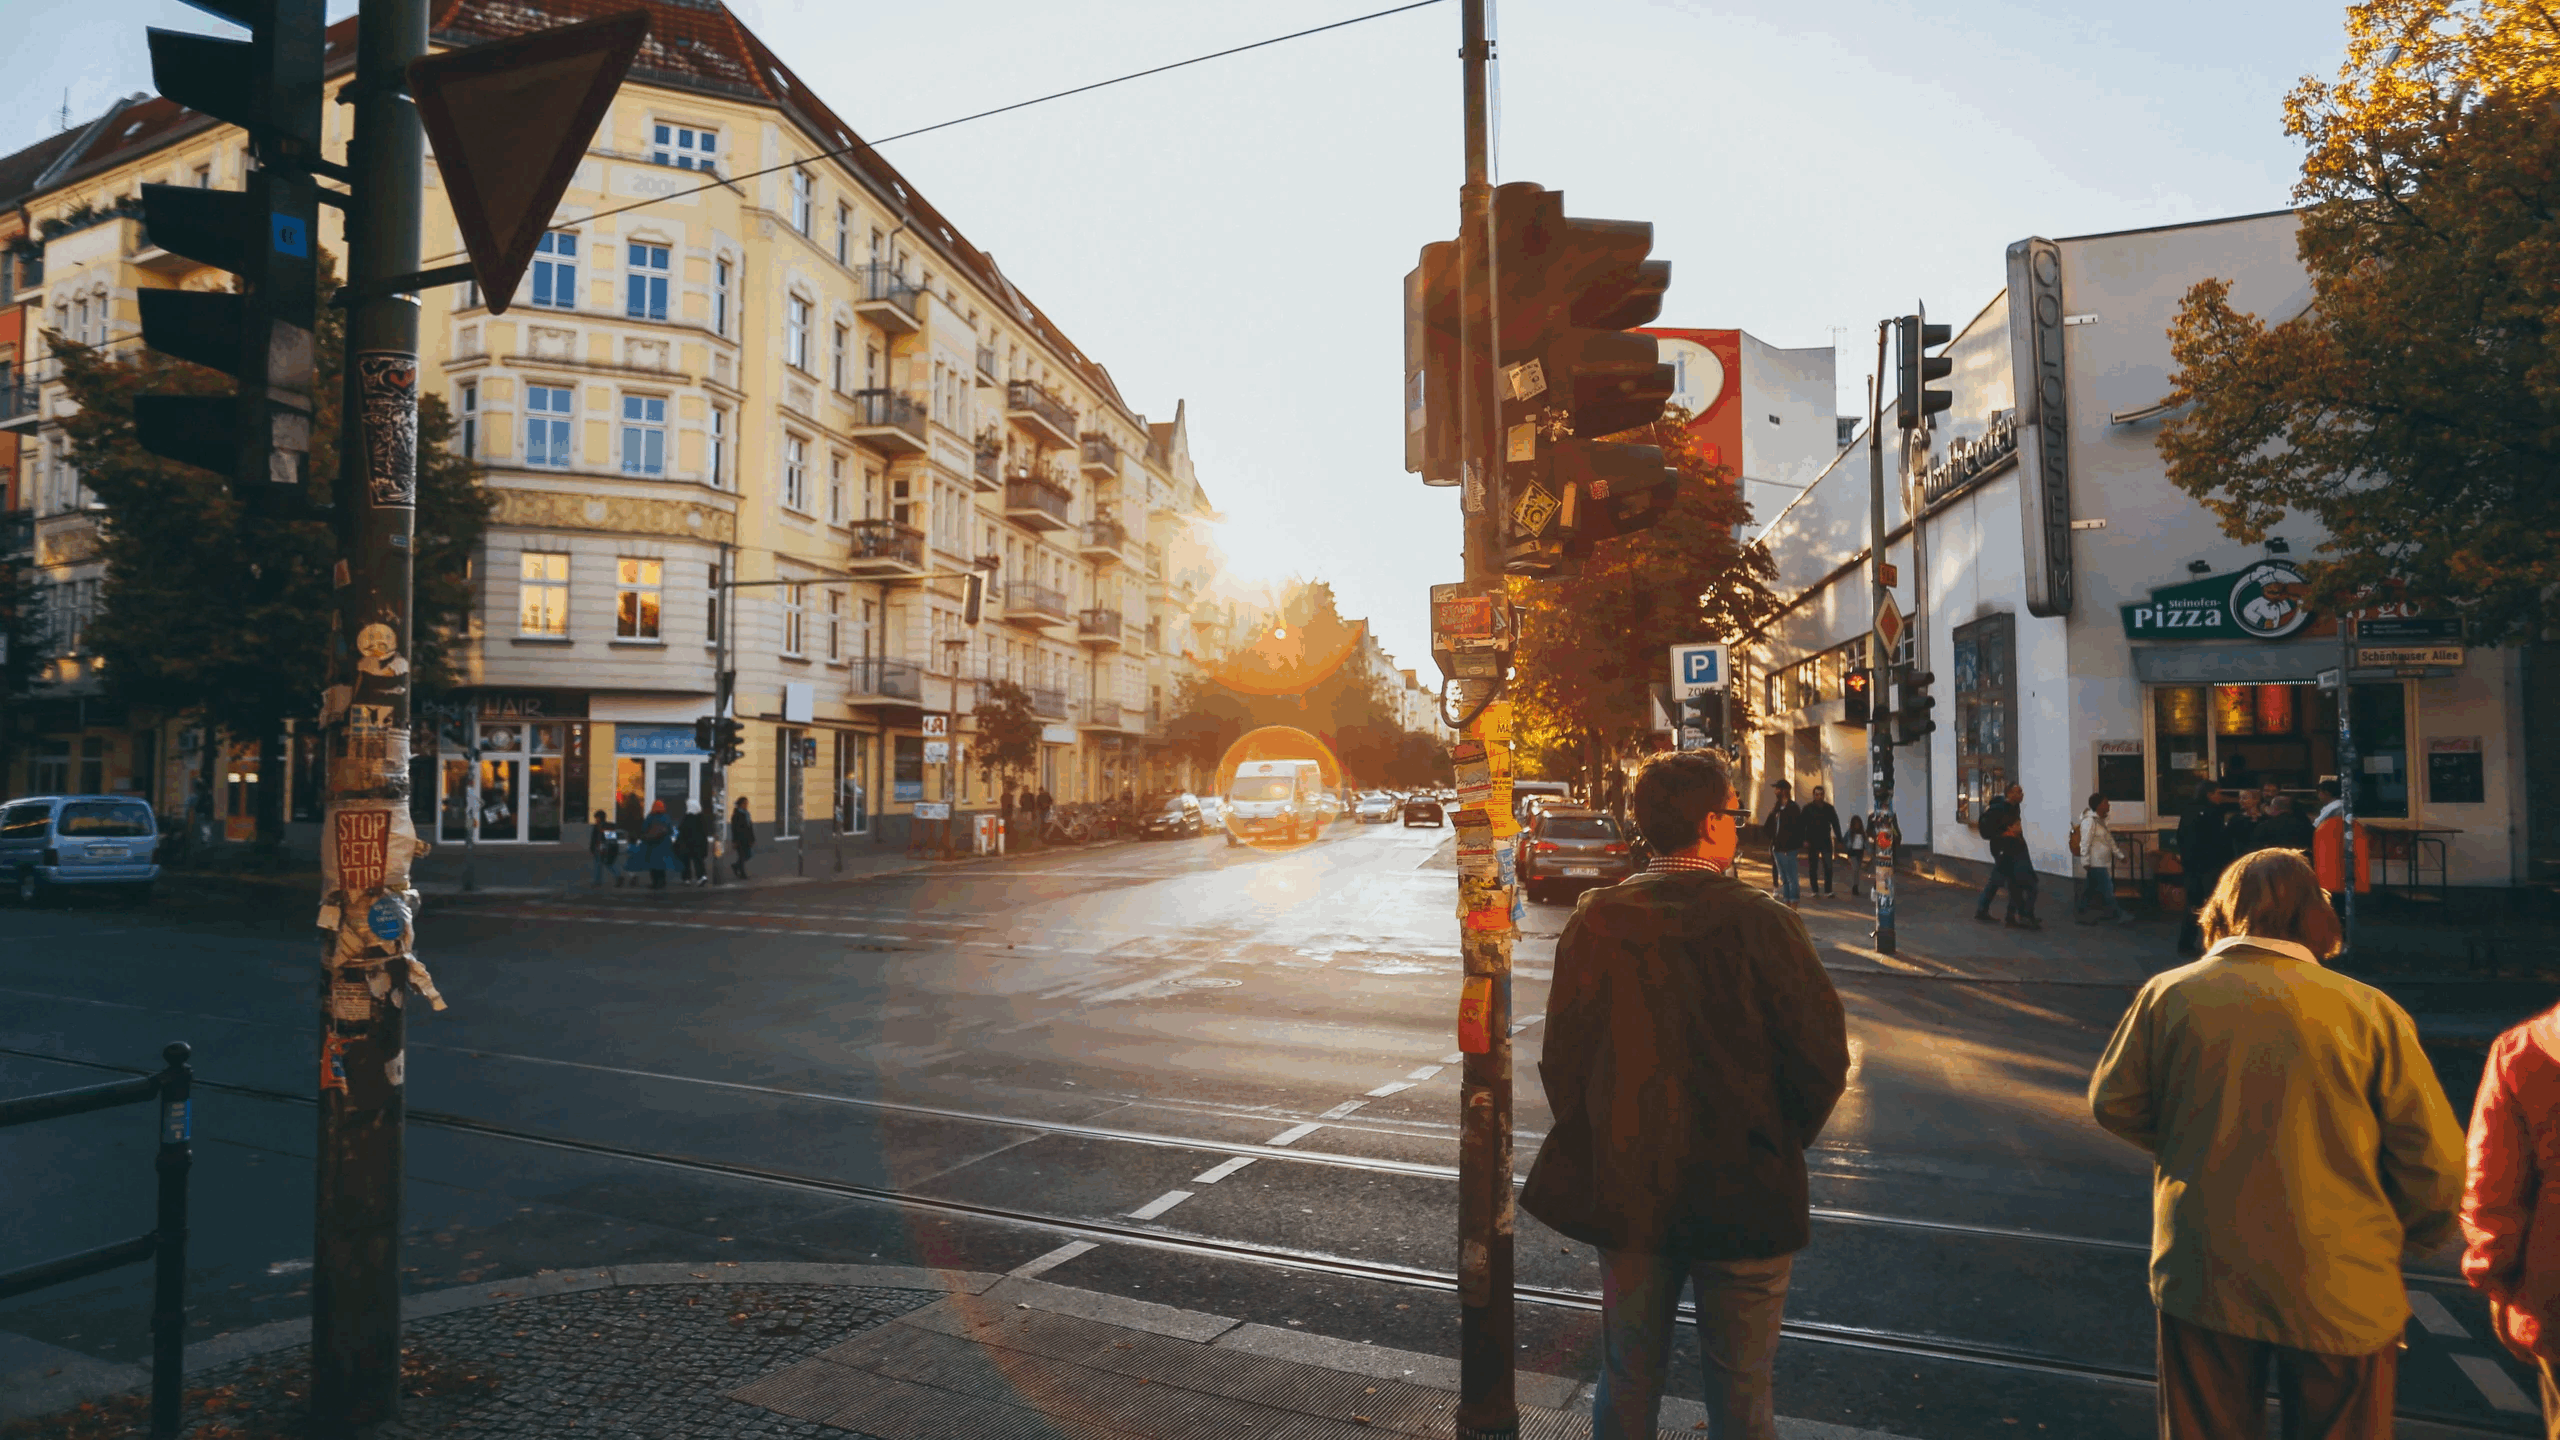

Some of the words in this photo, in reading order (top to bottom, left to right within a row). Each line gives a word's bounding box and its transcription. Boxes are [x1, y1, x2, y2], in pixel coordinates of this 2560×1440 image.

[2033, 249, 2072, 600] COLOSSEUM
[2134, 603, 2222, 629] Pizza
[1691, 655, 1710, 680] P
[2361, 651, 2427, 661] Schönhauser
[2432, 650, 2459, 660] Allee
[339, 812, 386, 841] STOP
[340, 841, 383, 867] CETA
